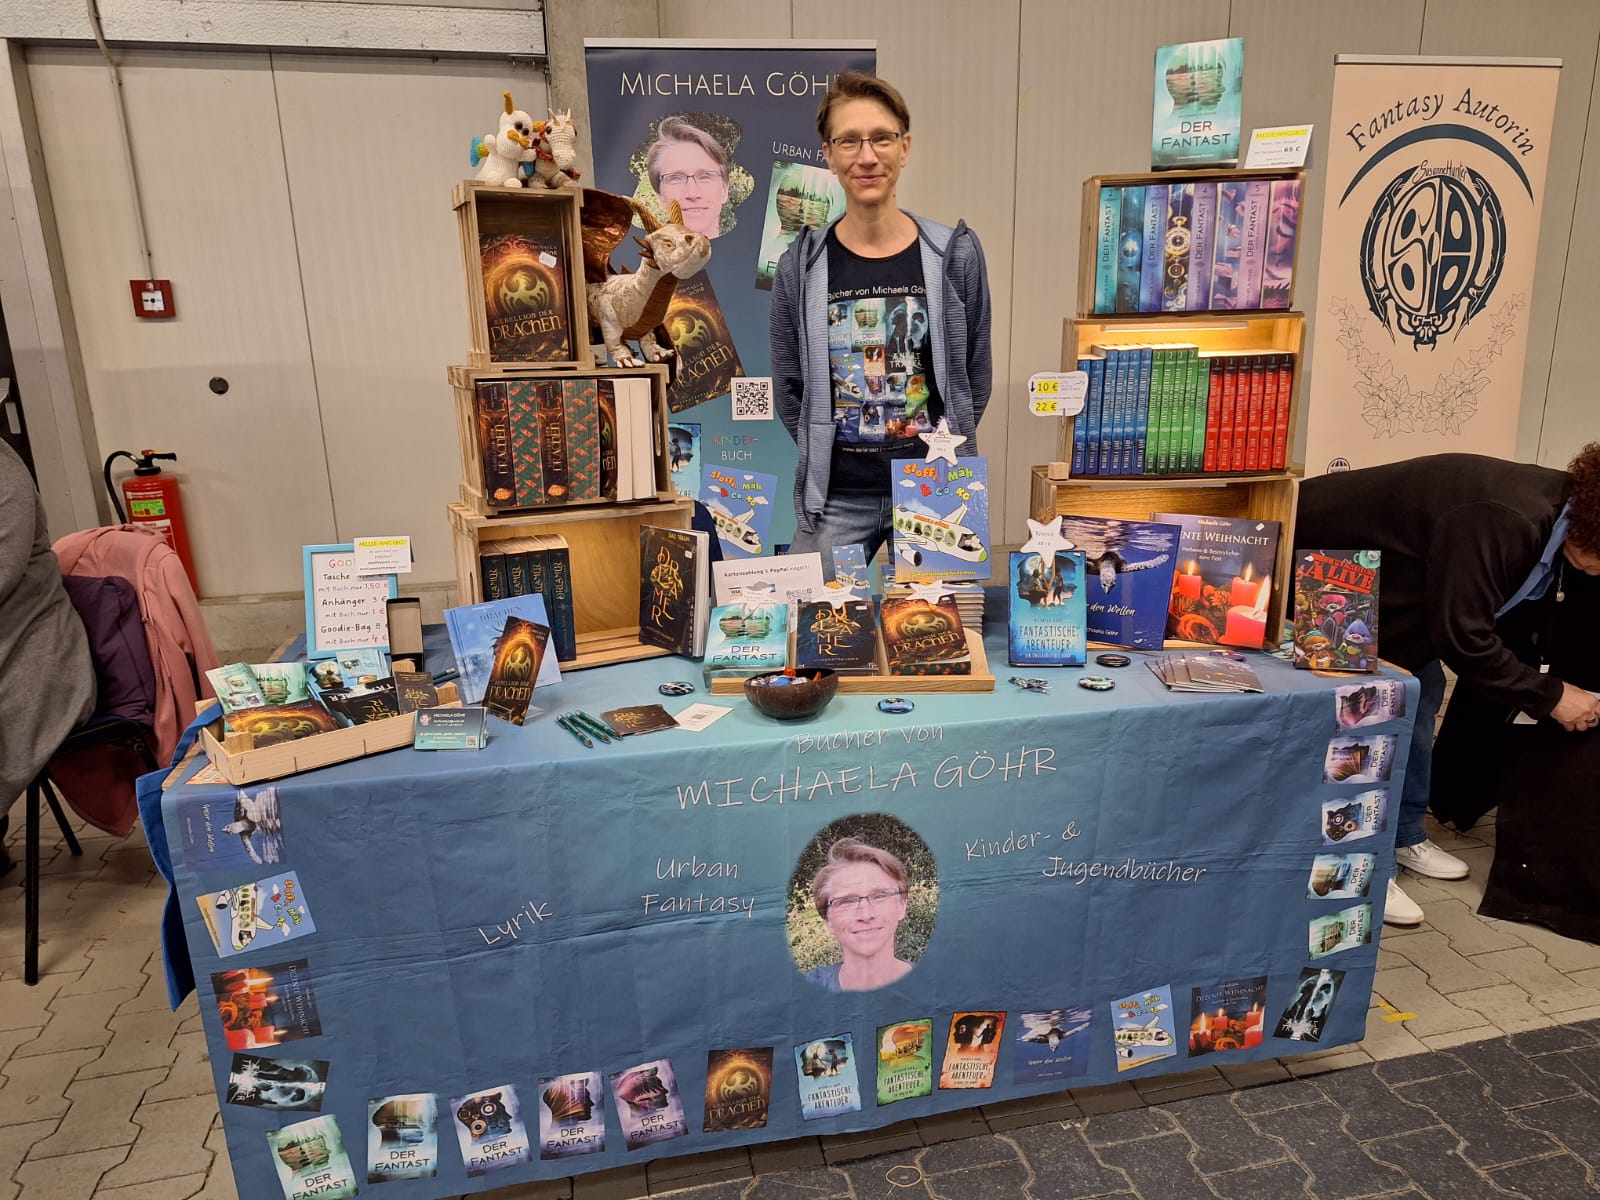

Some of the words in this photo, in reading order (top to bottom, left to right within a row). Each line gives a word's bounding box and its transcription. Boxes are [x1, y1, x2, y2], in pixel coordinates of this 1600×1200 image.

[620, 71, 755, 96] MICHAELA
[1180, 120, 1212, 134] DER
[1346, 92, 1444, 152] Fantasy
[1453, 87, 1535, 157] Autorin
[1161, 133, 1231, 150] FANTAST
[772, 141, 811, 160] URBAN
[1103, 205, 1111, 242] FANTAST
[1150, 202, 1159, 242] FANTAST
[1196, 202, 1206, 242] FANTAST
[1248, 200, 1258, 240] FANTAST
[1102, 245, 1110, 262] DER
[1148, 244, 1156, 261] DER
[1195, 243, 1203, 260] DER
[1246, 240, 1254, 258] DER
[855, 288, 870, 296] von
[872, 284, 908, 295] Michaela
[490, 315, 562, 341] DRACHEN
[1037, 382, 1050, 392] 10
[1052, 382, 1058, 391] €
[1036, 402, 1048, 412] 22
[1050, 402, 1057, 411] €
[714, 435, 759, 446] KINDER-
[721, 450, 752, 462] BUCH
[948, 466, 974, 482] Mäh
[1180, 530, 1202, 540] ENTE
[1204, 531, 1270, 546] WEIHNACHT
[323, 572, 350, 580] Tasche
[1303, 560, 1376, 590] ALIVE
[322, 598, 366, 608] Anhänger
[1089, 603, 1105, 612] den
[1107, 604, 1136, 616] Wellen
[320, 624, 371, 634] Goodie-Bag
[1019, 625, 1076, 638] FANTASTISCHE
[730, 646, 760, 654] DER
[1026, 638, 1071, 651] ABENTEUER
[712, 653, 777, 663] FANTAST
[899, 723, 944, 744] von
[1371, 750, 1380, 768] DER
[1376, 740, 1390, 778] FANTAST
[676, 760, 918, 811] MICHAELA
[932, 745, 1057, 789] GÖHR
[1372, 794, 1380, 830] FANTAST
[965, 830, 1051, 862] Kinder-
[1062, 820, 1081, 840] &
[656, 856, 740, 880] Urban
[1042, 856, 1208, 886] Jugendbücher
[1350, 867, 1360, 884] DER
[1354, 858, 1369, 894] FANTAST
[641, 892, 756, 919] Fantasy
[478, 900, 553, 945] Lyrik
[1349, 920, 1357, 936] DER
[1356, 910, 1366, 942] FANTAST
[641, 1114, 665, 1127] DER
[560, 1127, 584, 1138] DER
[630, 1120, 680, 1140] FANTAST
[482, 1141, 507, 1154] DER
[546, 1134, 599, 1150] FANTAST
[390, 1150, 416, 1160] DER
[470, 1146, 523, 1167] FANTAST
[375, 1158, 430, 1173] FANTAST
[292, 1178, 349, 1200] FANTAST
[304, 1173, 332, 1188] DER
